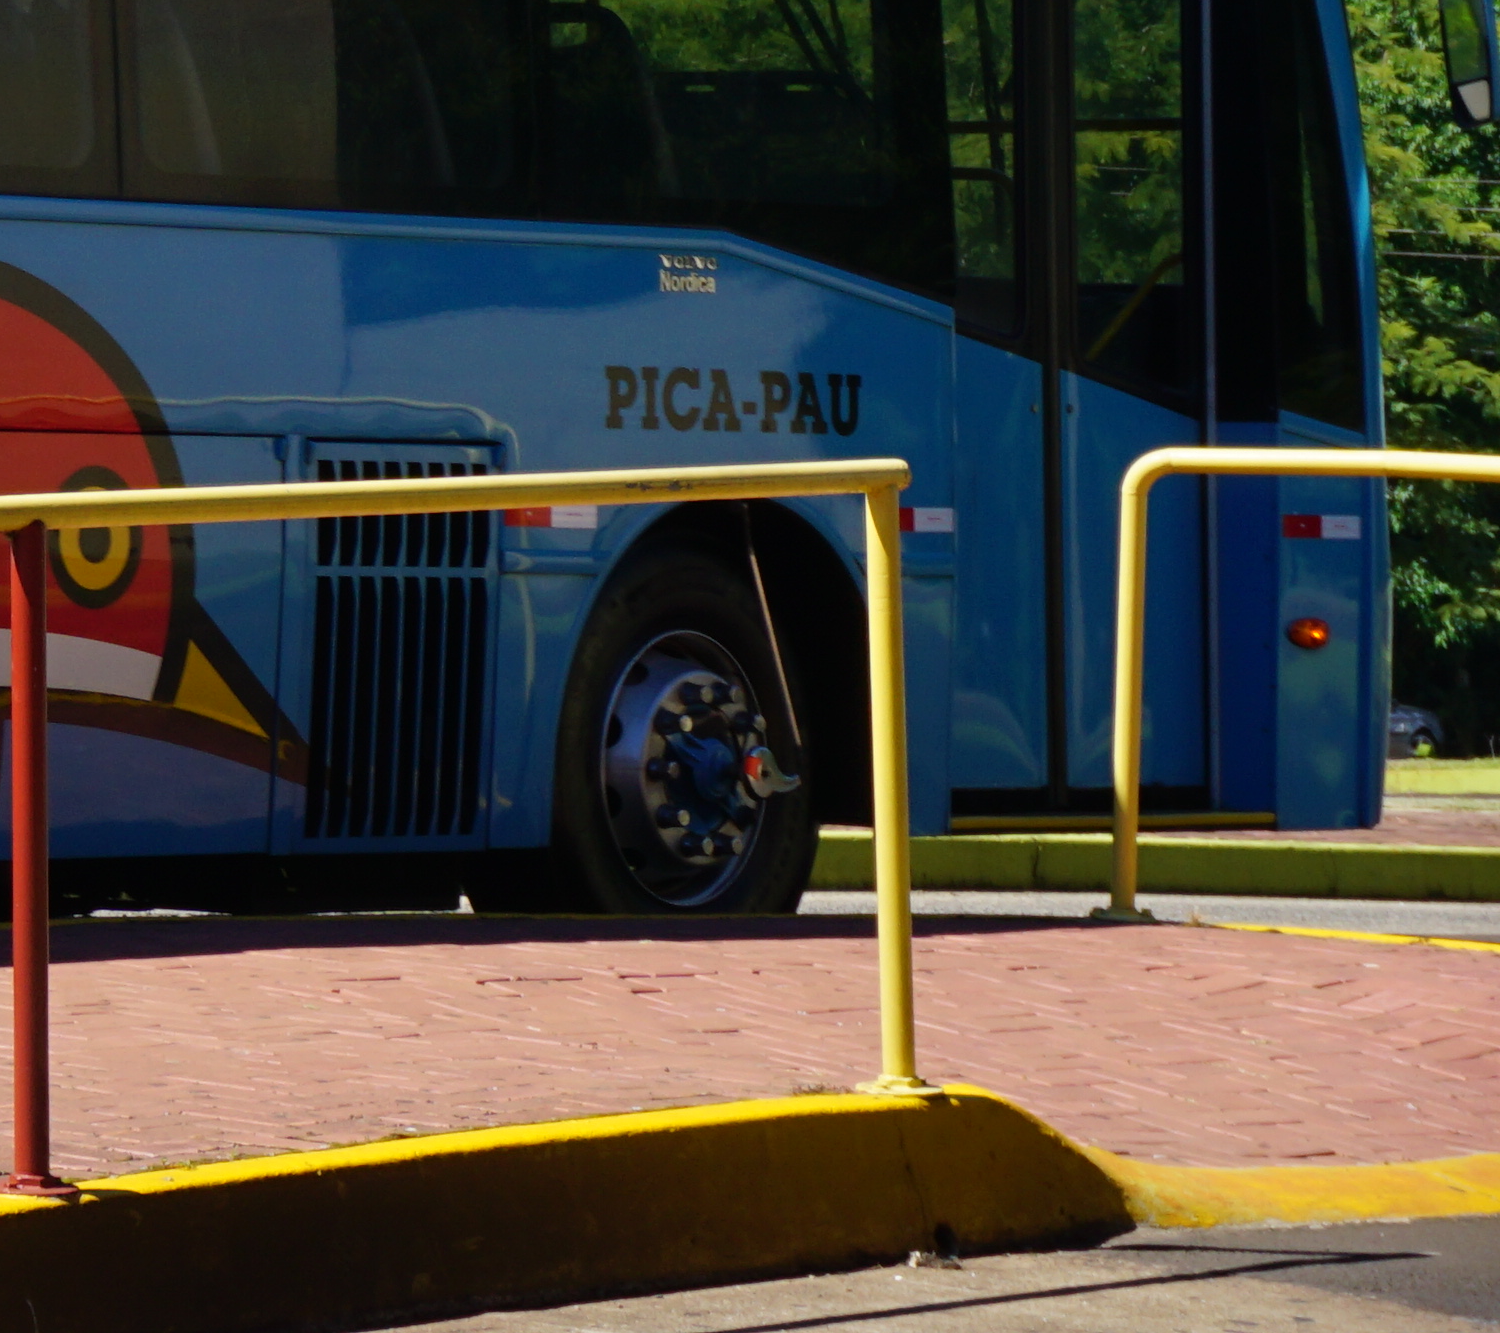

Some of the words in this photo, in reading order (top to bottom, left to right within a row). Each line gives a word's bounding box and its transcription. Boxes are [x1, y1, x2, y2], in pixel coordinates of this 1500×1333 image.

[658, 253, 718, 270] VOLVO
[659, 268, 716, 293] Nordica
[604, 365, 862, 436] PICA-PAU
